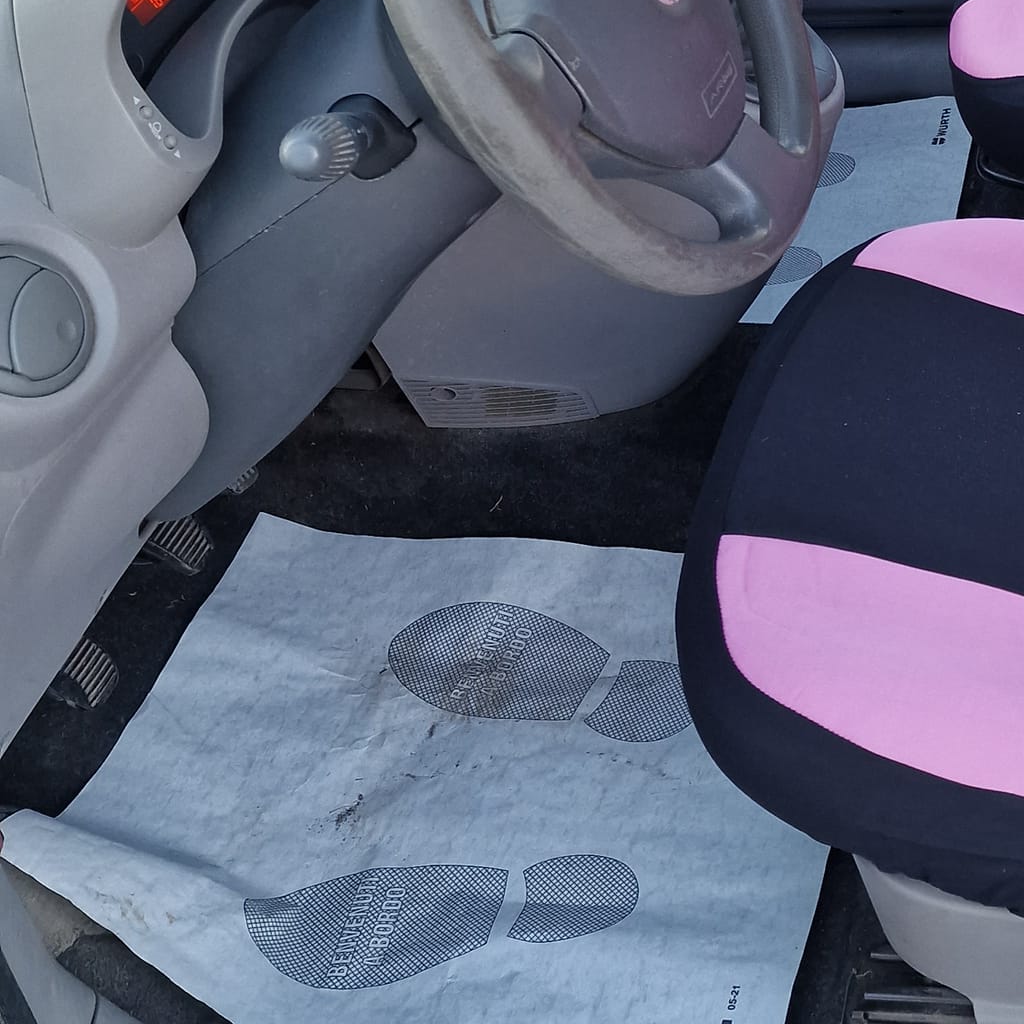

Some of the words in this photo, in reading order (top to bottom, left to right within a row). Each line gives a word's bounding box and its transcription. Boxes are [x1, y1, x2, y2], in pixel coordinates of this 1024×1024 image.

[488, 627, 533, 682] BORDO
[327, 877, 381, 978] BENVENUTI
[368, 887, 406, 948] BORDO
[363, 955, 382, 967] A
[727, 986, 740, 1010] 05-21
